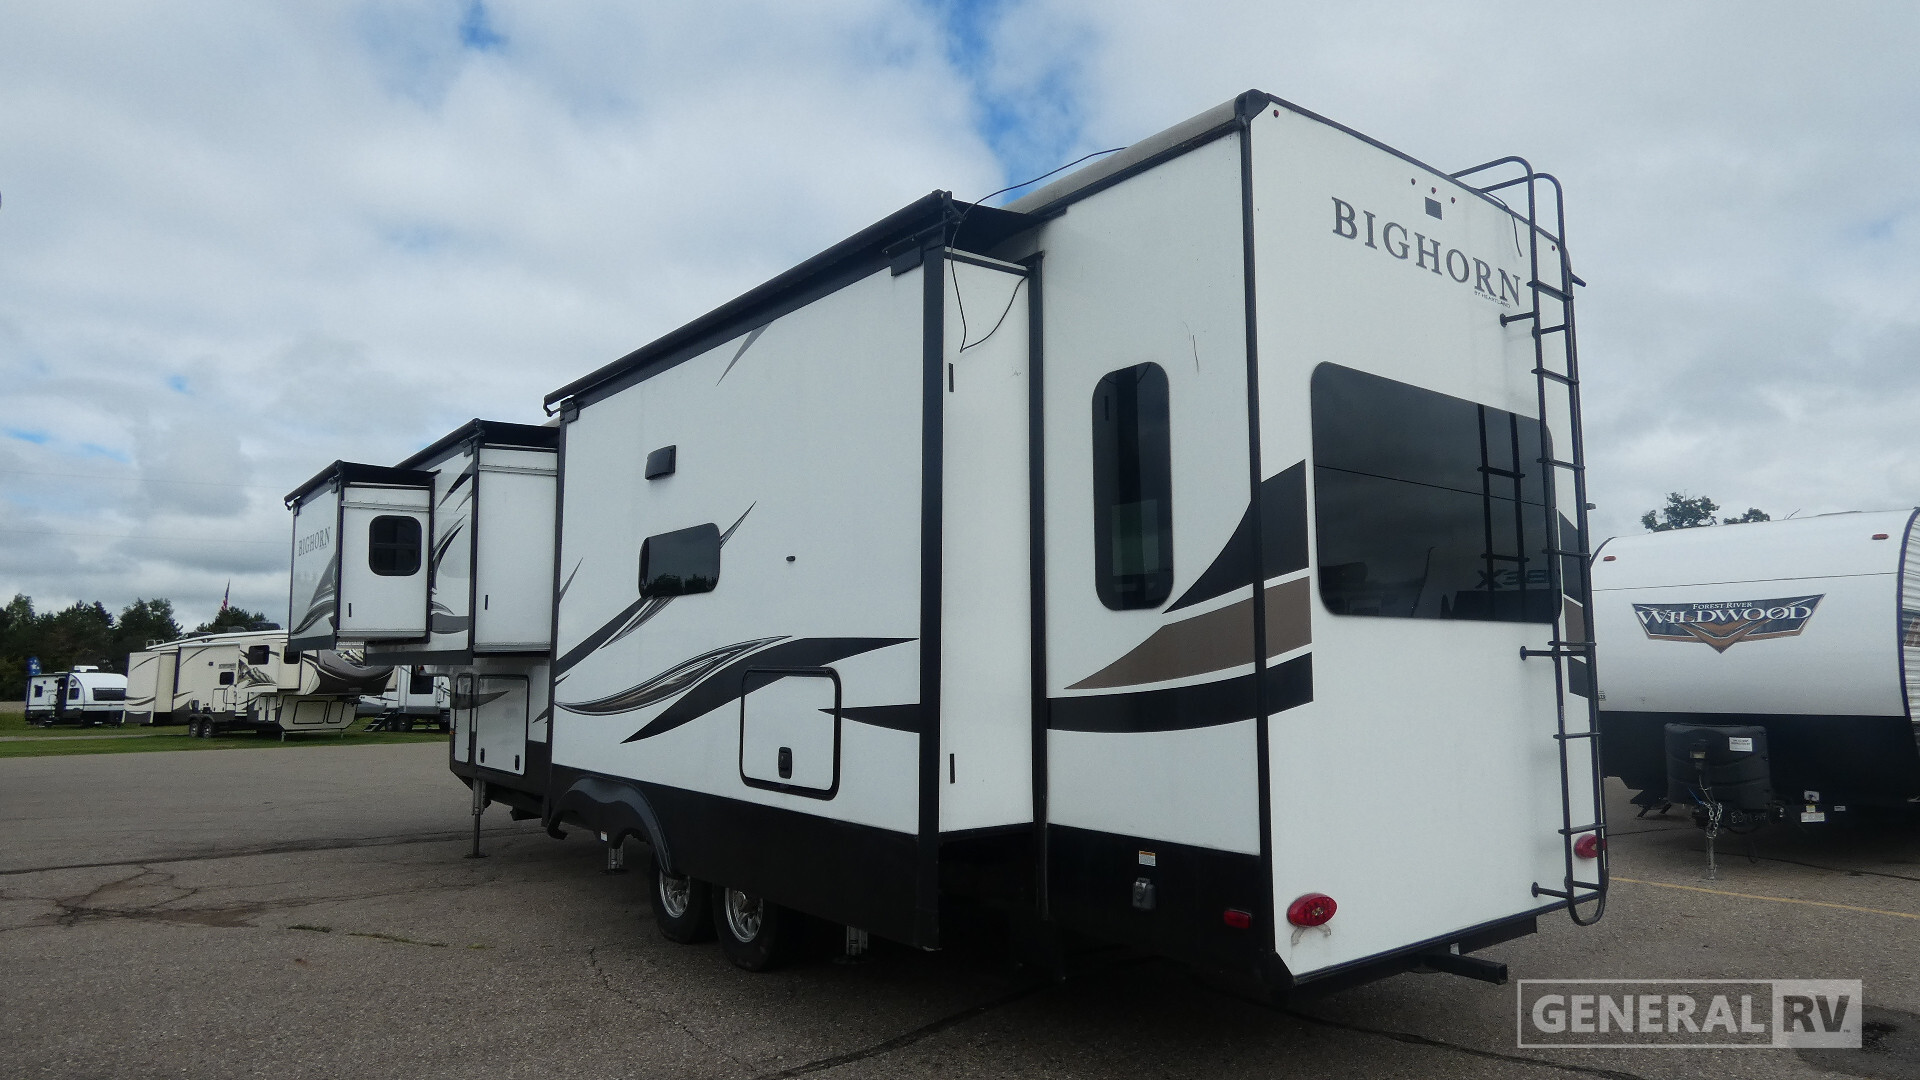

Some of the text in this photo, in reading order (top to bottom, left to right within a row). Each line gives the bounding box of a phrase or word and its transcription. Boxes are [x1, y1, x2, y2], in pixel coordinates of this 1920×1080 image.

[1332, 196, 1520, 306] BIGHORN
[298, 526, 331, 557] BIGHORN
[1636, 606, 1813, 625] WILDWOOD
[1692, 601, 1753, 610] FOREST RIVER
